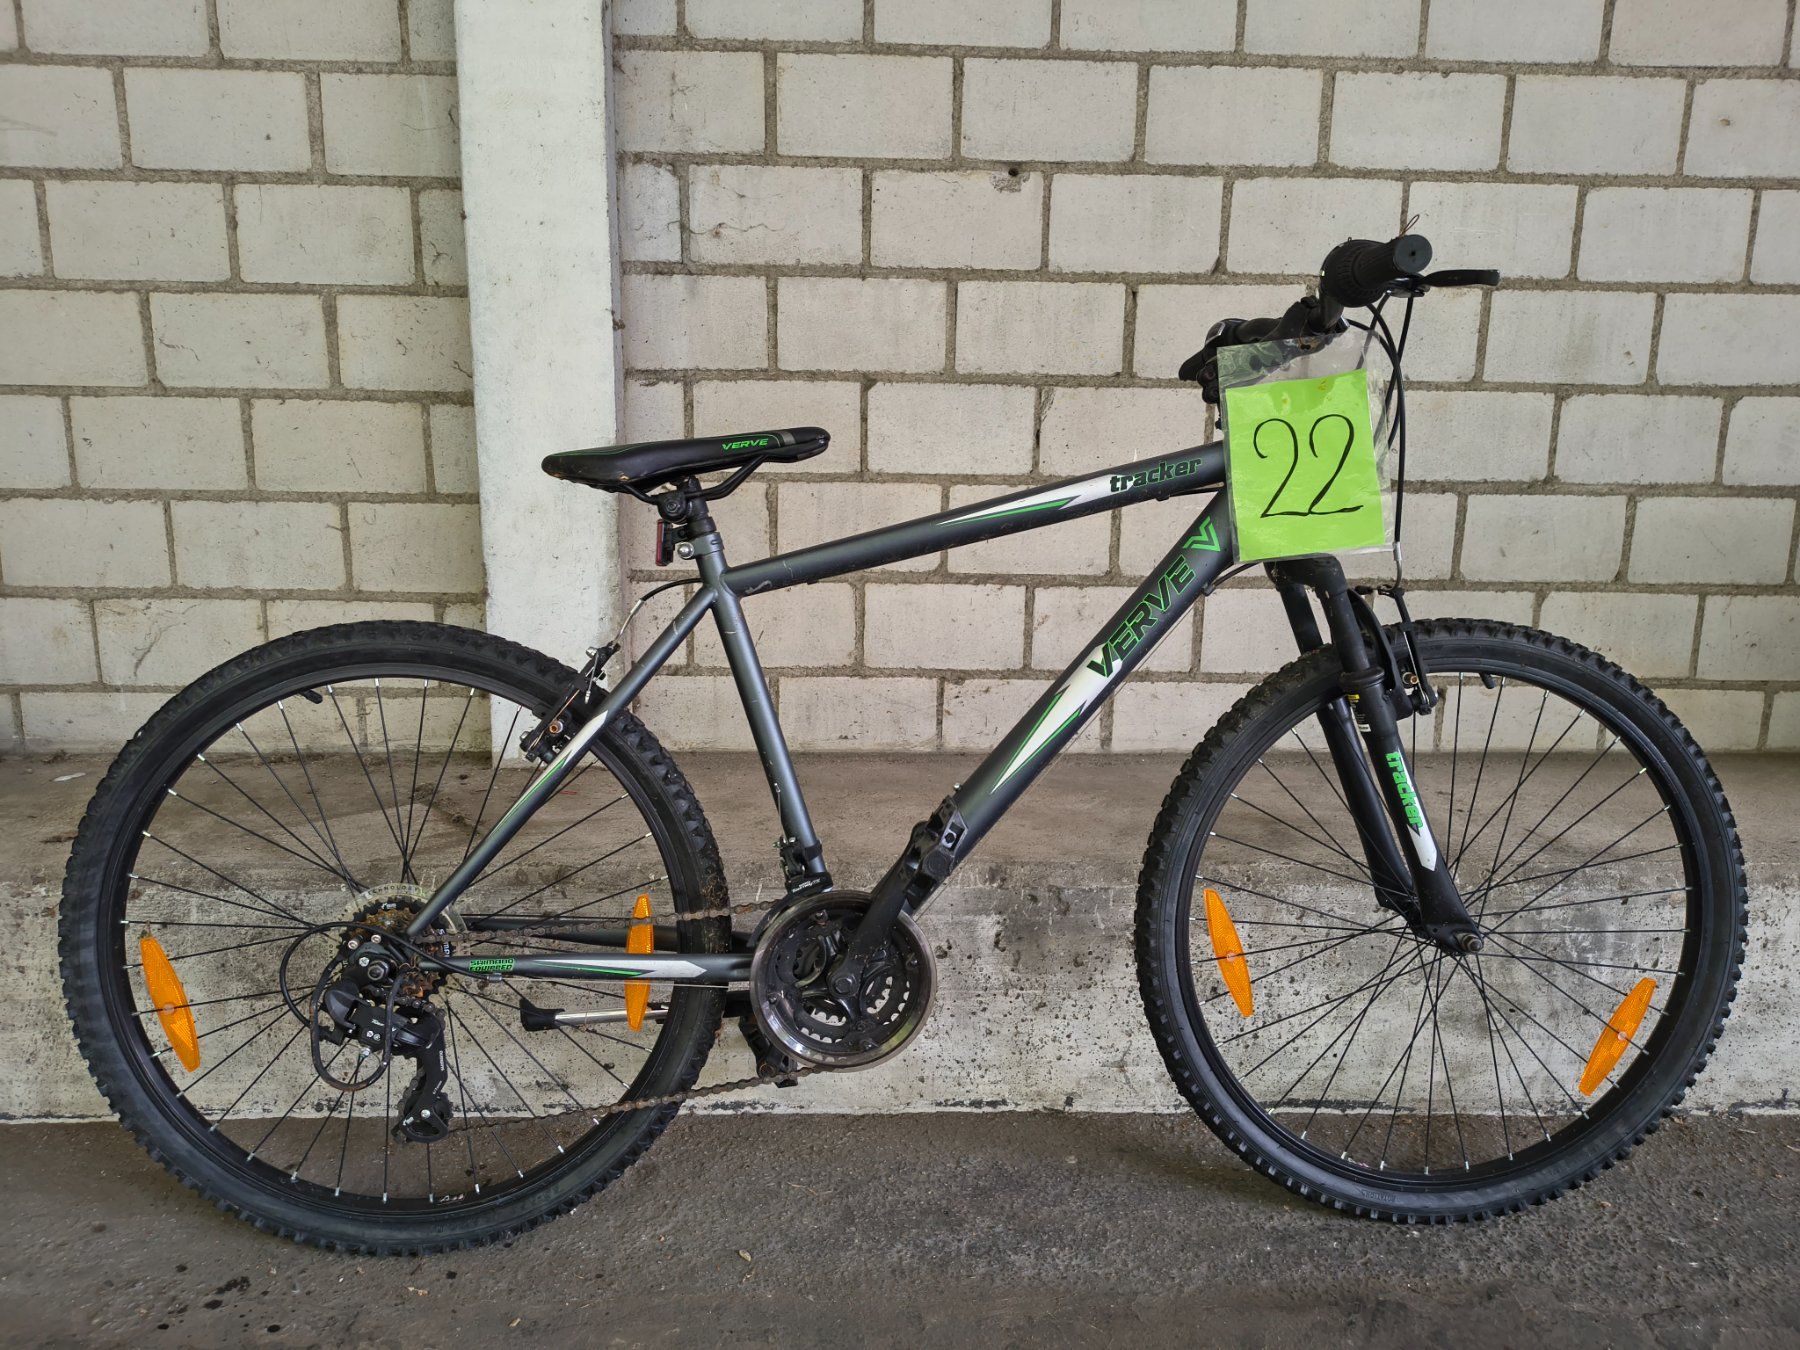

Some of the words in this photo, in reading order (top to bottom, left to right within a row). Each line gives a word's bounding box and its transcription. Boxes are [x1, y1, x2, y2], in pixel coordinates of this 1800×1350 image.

[721, 438, 769, 451] VERVE
[1109, 458, 1202, 493] tracker
[1253, 413, 1364, 519] 22
[1086, 555, 1198, 678] VERVE
[1384, 751, 1424, 829] tracker
